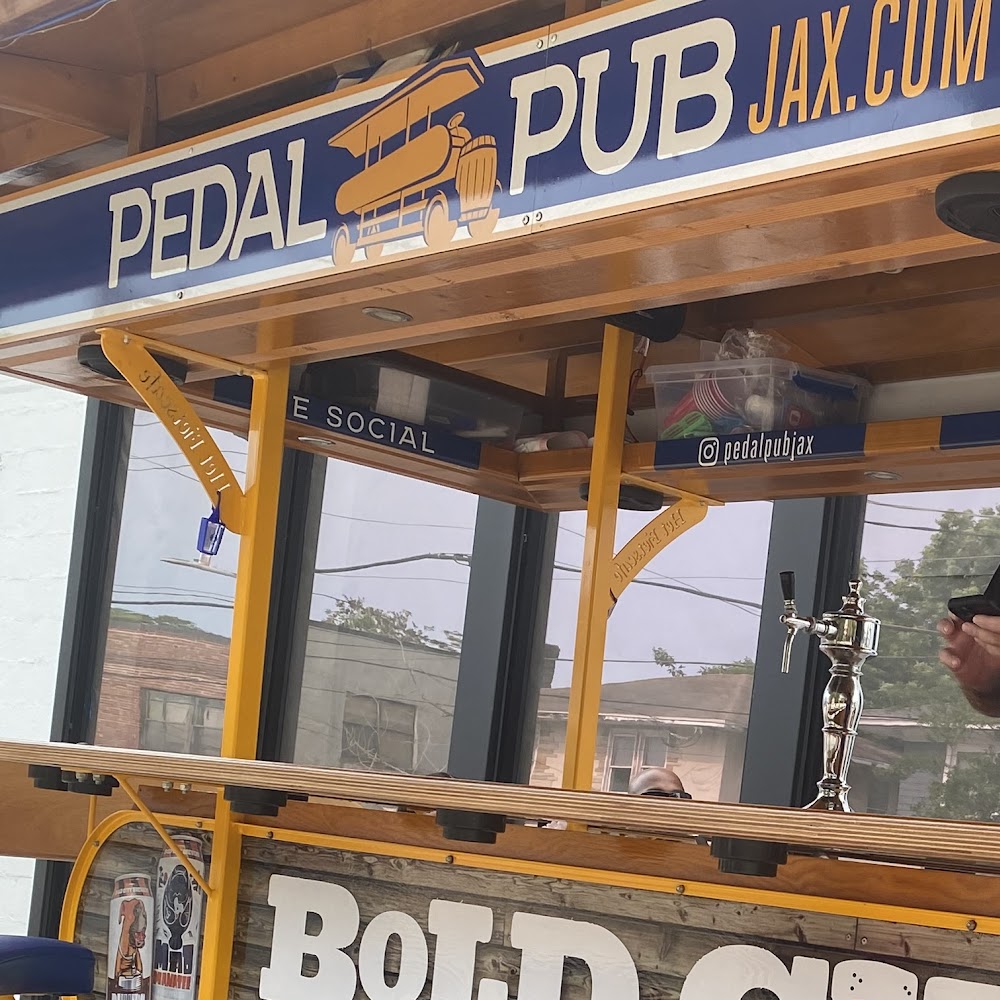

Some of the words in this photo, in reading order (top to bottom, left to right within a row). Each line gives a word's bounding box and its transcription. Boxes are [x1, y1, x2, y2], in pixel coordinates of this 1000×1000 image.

[108, 138, 328, 289] PEDAL
[508, 16, 736, 195] PUB
[748, 0, 992, 134] JAX.COM
[292, 395, 310, 420] E
[326, 405, 435, 454] SOCIAL
[724, 431, 814, 466] pedalpubjax
